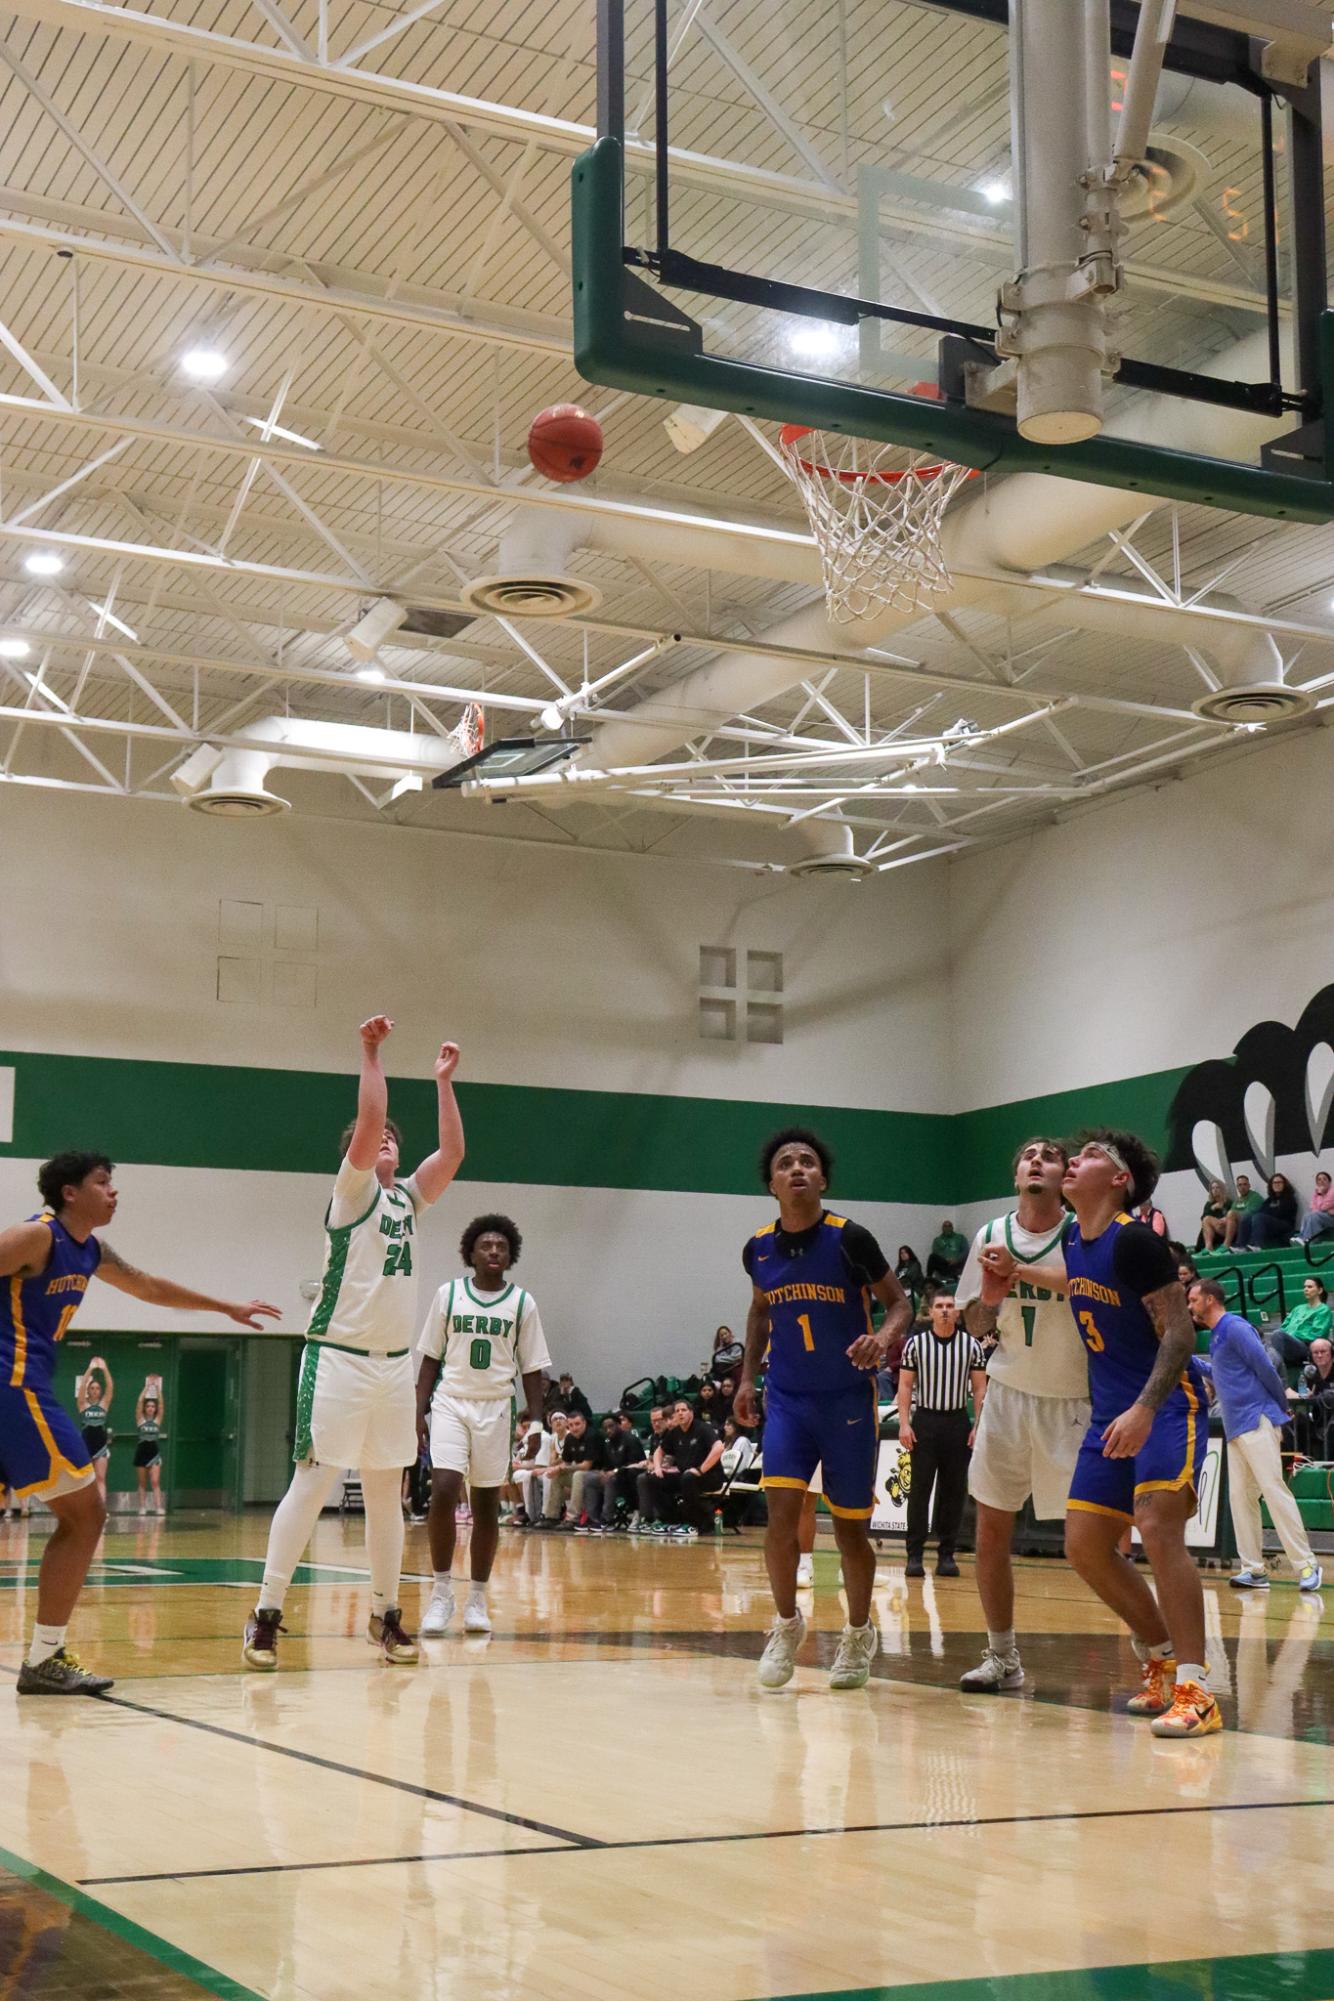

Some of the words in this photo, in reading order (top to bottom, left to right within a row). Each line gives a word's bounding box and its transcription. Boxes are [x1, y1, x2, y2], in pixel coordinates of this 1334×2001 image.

[382, 1241, 412, 1276] 24
[453, 1315, 514, 1338] DERBY
[797, 1314, 815, 1352] 1
[1021, 1306, 1036, 1347] 1
[1079, 1311, 1105, 1352] 3
[469, 1339, 491, 1369] 0
[892, 1521, 906, 1530] STATE
